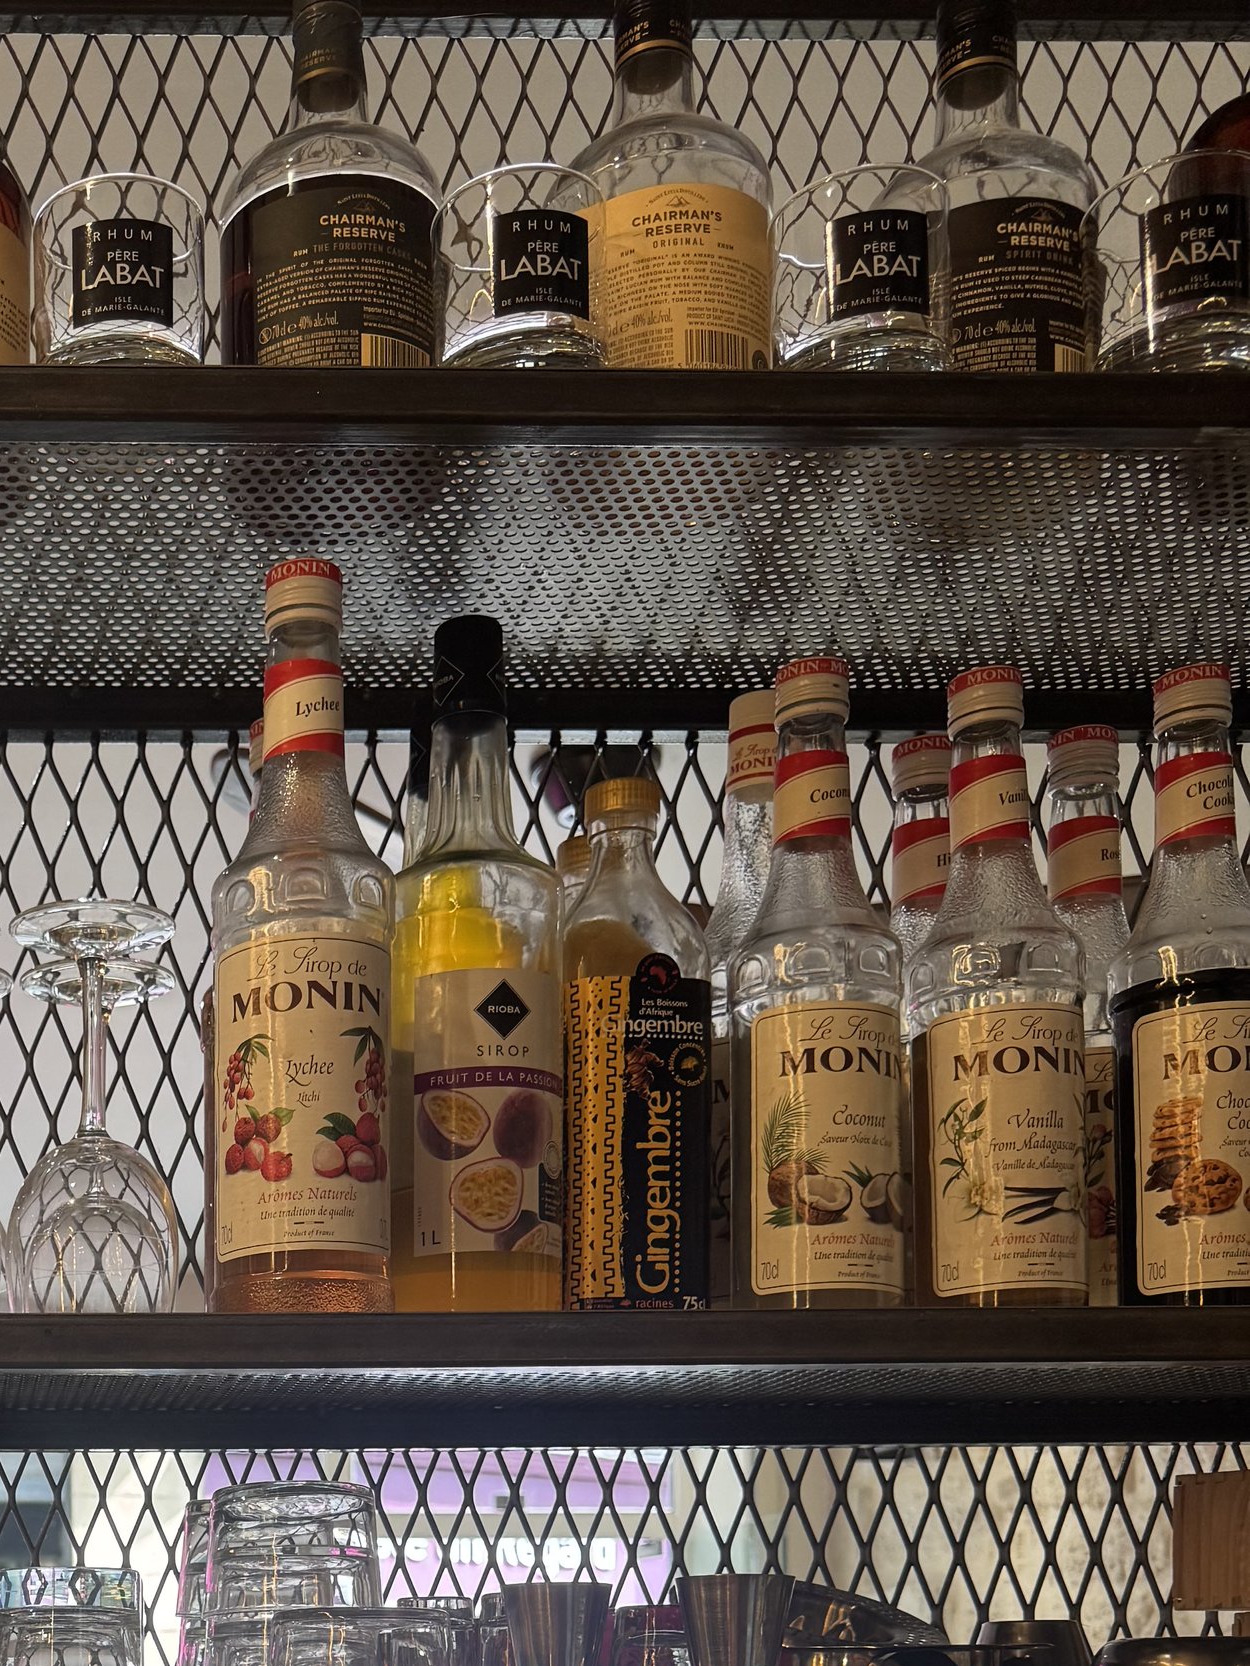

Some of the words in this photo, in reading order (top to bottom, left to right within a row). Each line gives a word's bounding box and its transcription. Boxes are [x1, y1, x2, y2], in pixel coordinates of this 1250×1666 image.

[631, 210, 723, 228] CHAIRMAN'S
[1163, 204, 1229, 225] RHUM
[319, 214, 406, 233] CHAIRMAN'S
[512, 220, 571, 234] RHUM
[645, 223, 711, 238] RESERVE
[847, 219, 909, 236] RHUM
[996, 222, 1079, 242] CHAIRMAN'S
[93, 228, 153, 242] RHUM
[333, 228, 396, 242] RESERVE
[652, 237, 705, 249] ORIGINAL
[1010, 235, 1070, 252] RESERVE
[293, 248, 309, 257] RUM
[620, 248, 636, 258] RUM
[978, 254, 995, 263] RUM
[1150, 239, 1242, 276] LABAT
[500, 254, 582, 281] LABAT
[835, 254, 921, 286] LABAT
[81, 263, 165, 291] LABAT
[1190, 273, 1209, 283] ISLE
[872, 287, 890, 295] ISLE
[1153, 291, 1165, 301] DE
[1168, 280, 1243, 295] MARIE-GALANTE
[501, 299, 512, 307] DE
[515, 294, 582, 308] MARIE-GALANTE
[836, 303, 848, 312] DE
[851, 295, 922, 306] MARIE-GALANTE
[81, 308, 92, 316] DE
[94, 304, 165, 316] MARIE-GALANTE
[271, 559, 331, 582] MONIN
[967, 668, 1022, 686] MONIN
[1162, 664, 1223, 688] MONIN
[295, 696, 340, 718] Lychee
[898, 735, 951, 754] MONIN
[246, 950, 279, 982] Le
[284, 946, 342, 980] Sirop
[347, 960, 367, 977] de
[232, 980, 381, 1023] MONIN
[487, 1005, 521, 1014] RIOBA
[641, 998, 655, 1007] Les
[656, 998, 688, 1008] Boissons
[639, 1008, 674, 1018] d'Afrique
[799, 1015, 834, 1042] Le
[839, 1015, 886, 1049] Sirop
[971, 1017, 1007, 1046] Le
[1011, 1015, 1062, 1046] Sirop
[1182, 1016, 1218, 1044] Le
[477, 1045, 530, 1058] SIROP
[285, 1055, 335, 1087] Lychee
[779, 1046, 901, 1081] MONIN
[953, 1046, 1085, 1082] MONIN
[430, 1073, 469, 1087] FRUIT
[475, 1072, 492, 1082] DE
[499, 1072, 513, 1082] LA
[519, 1073, 558, 1088] PASSION
[832, 1104, 887, 1128] Coconut
[1007, 1108, 1064, 1129] Vanilla
[817, 1131, 849, 1146] Saveur
[985, 1138, 1016, 1158] from
[1017, 1132, 1078, 1154] Madagascar
[992, 1159, 1026, 1171] Vanille
[1026, 1159, 1036, 1169] de
[258, 1189, 304, 1205] Arômes
[308, 1185, 358, 1202] Naturels
[635, 1090, 681, 1294] Gingembre
[260, 1210, 278, 1221] Une
[278, 1205, 317, 1218] tradition
[317, 1204, 328, 1216] de
[432, 1230, 441, 1245] L
[810, 1232, 857, 1246] Arômes
[990, 1232, 1036, 1247] Arômes
[1200, 1231, 1246, 1245] Arômes
[814, 1251, 832, 1260] Une
[832, 1249, 867, 1260] tradition
[1012, 1249, 1048, 1260] tradition
[1048, 1249, 1057, 1259] de
[1201, 1248, 1220, 1260] Une
[760, 1258, 780, 1281] 70cl
[941, 1261, 960, 1283] 70cl
[1147, 1258, 1166, 1281] 70cl
[635, 1298, 674, 1309] racines
[682, 1295, 707, 1311] 75cl
